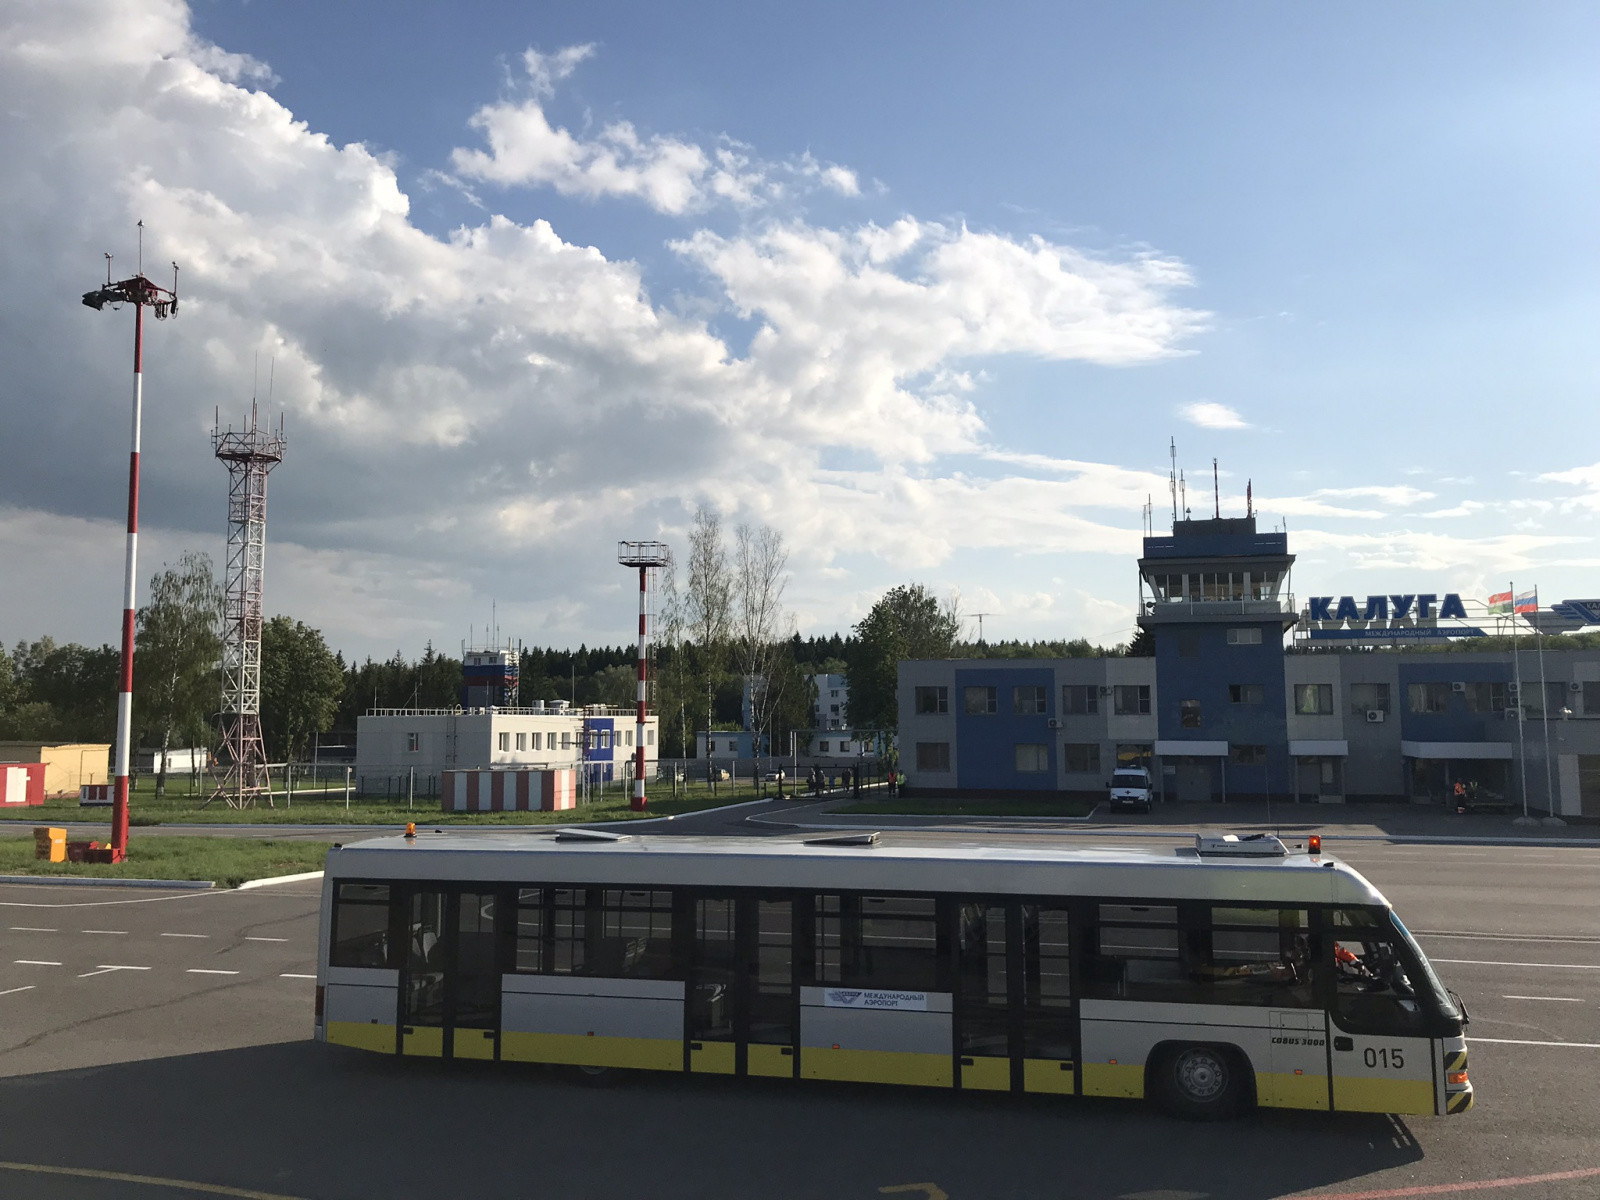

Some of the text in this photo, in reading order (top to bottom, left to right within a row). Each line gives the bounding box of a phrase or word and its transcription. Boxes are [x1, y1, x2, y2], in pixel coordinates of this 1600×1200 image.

[1308, 593, 1468, 621] КАЛУГА
[1365, 628, 1474, 637] МЕЖДУНАРОДНЫЙ АЭРОПОРТ
[863, 992, 925, 1001] МЕЖДУНАРОДНЫЙ
[1271, 1037, 1300, 1045] COBUS
[1363, 1047, 1405, 1069] 015
